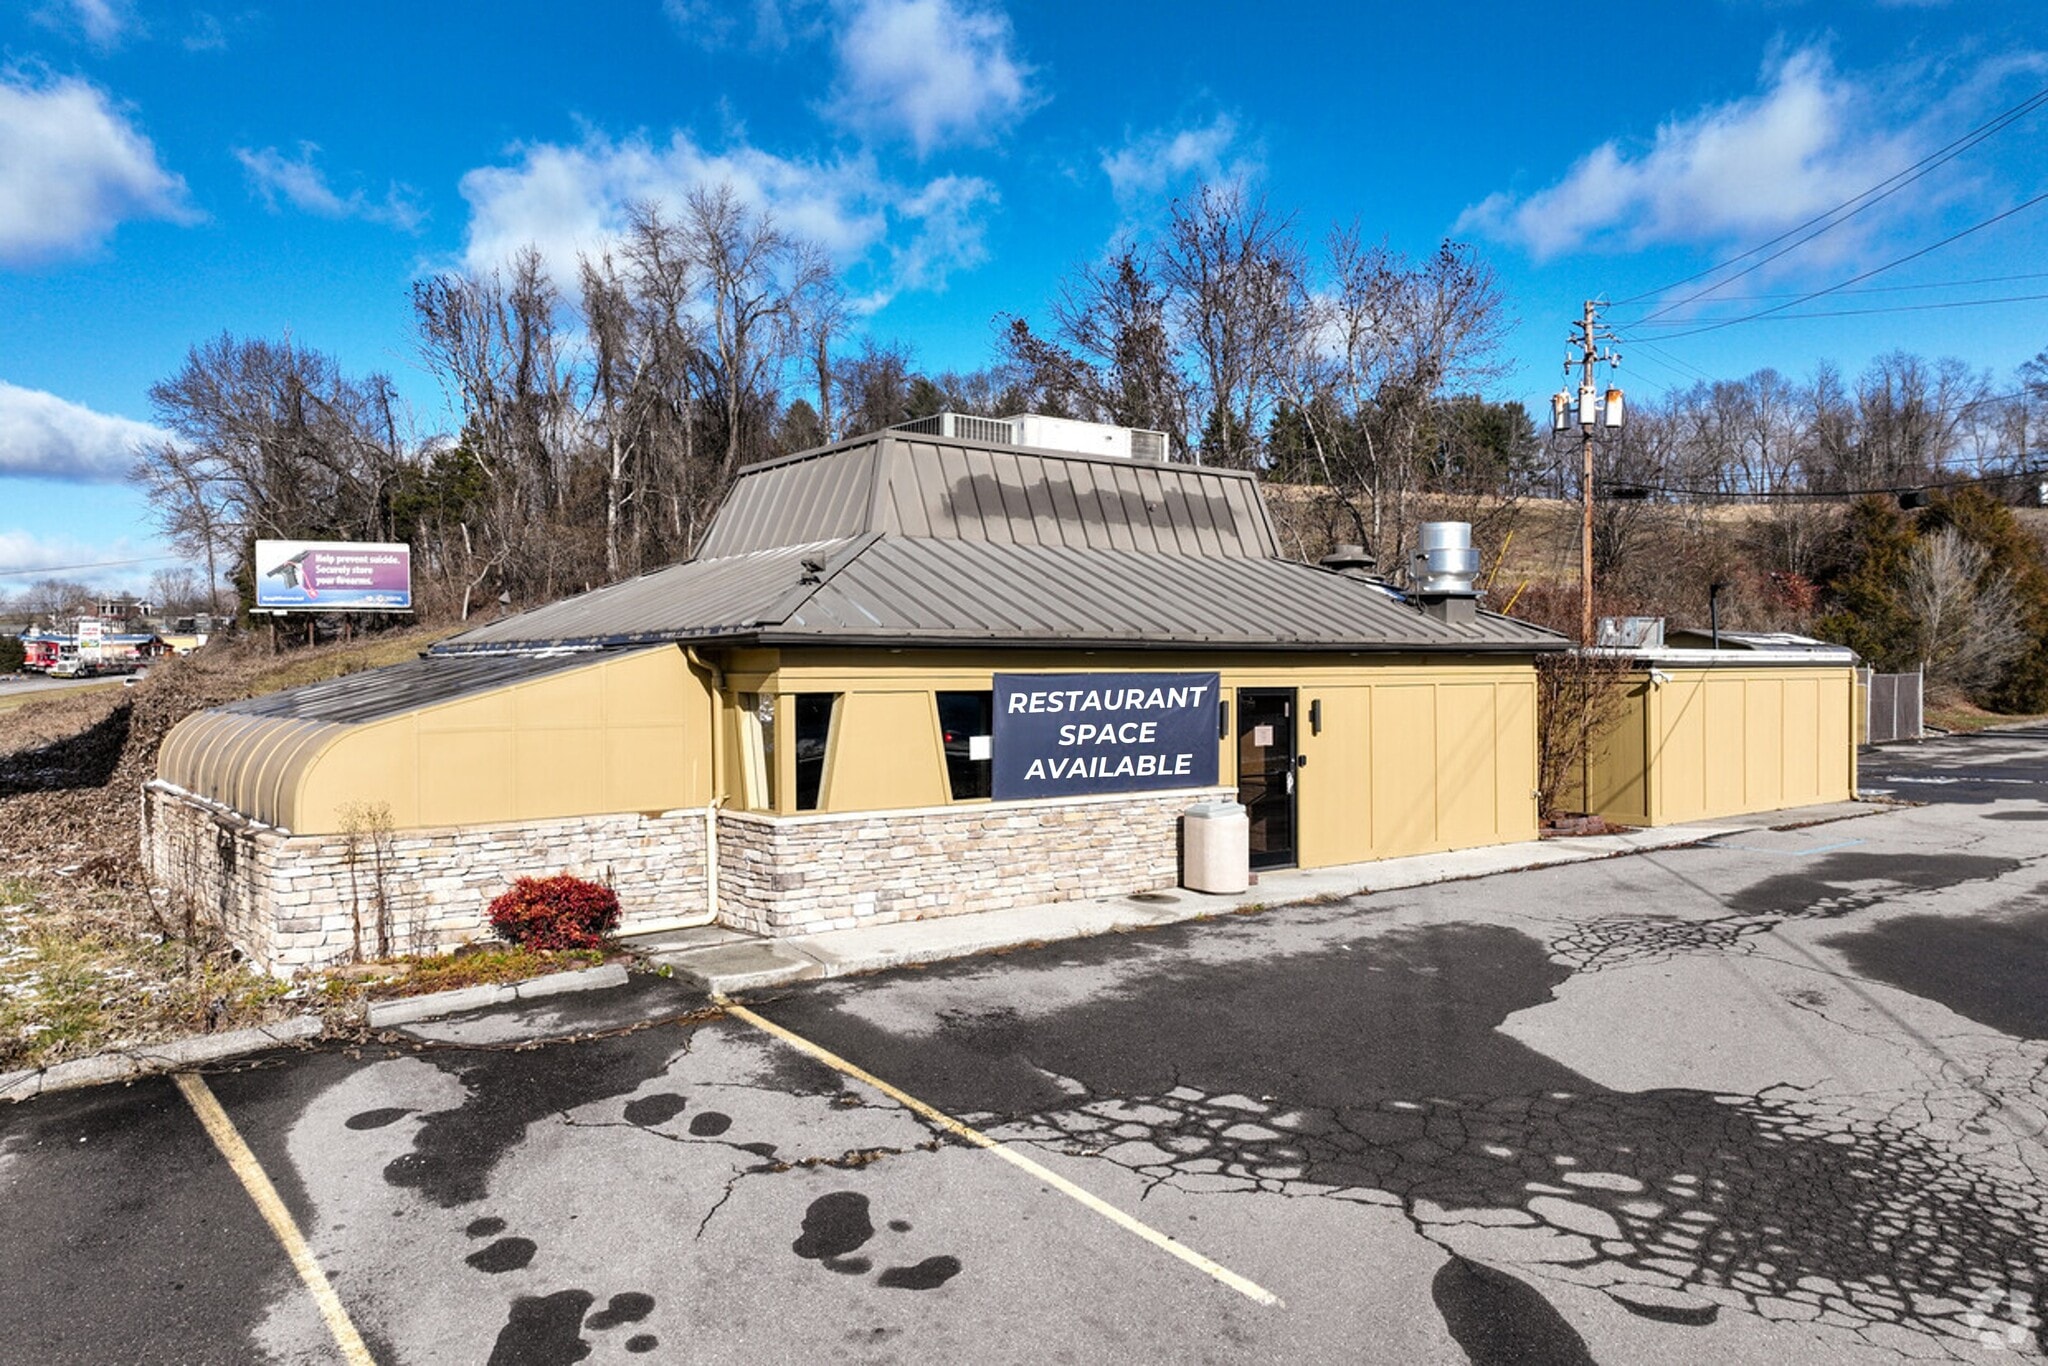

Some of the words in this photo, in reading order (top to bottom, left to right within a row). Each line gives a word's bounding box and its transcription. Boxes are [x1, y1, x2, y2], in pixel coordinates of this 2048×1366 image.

[315, 554, 335, 564] Help
[336, 555, 369, 565] prevent
[370, 555, 400, 564] suicide.
[315, 564, 350, 576] Securely
[352, 566, 373, 574] store
[315, 577, 335, 586] your
[336, 575, 373, 585] firearms.
[1008, 686, 1208, 714] RESTAURANT
[1058, 722, 1158, 746] SPACE
[1023, 753, 1193, 780] AVAILABLE
